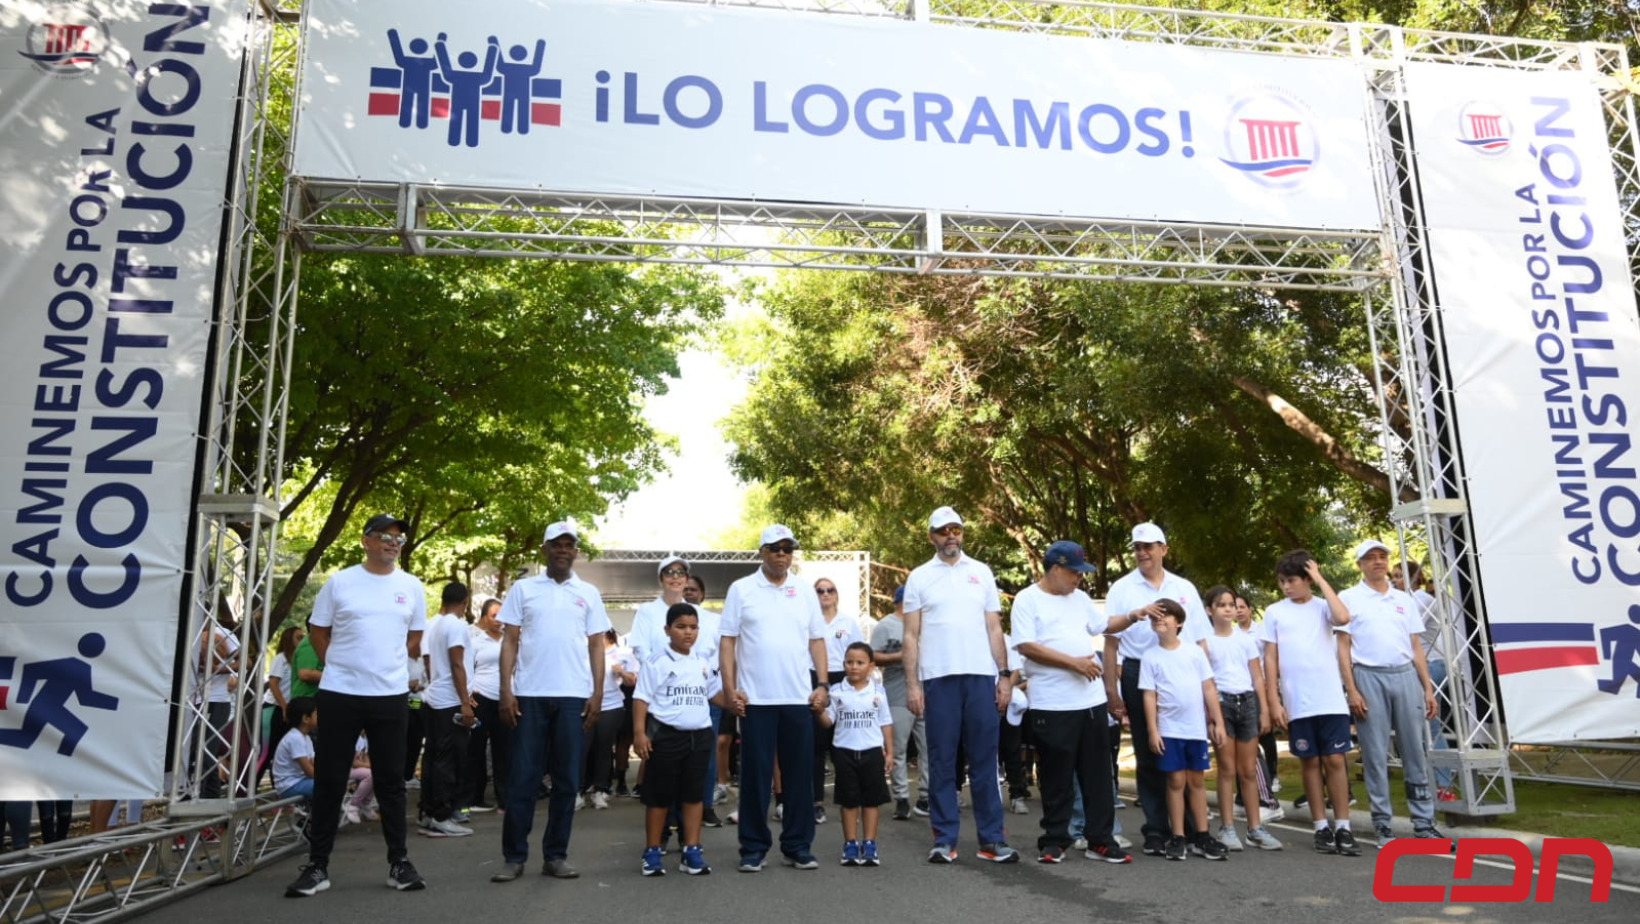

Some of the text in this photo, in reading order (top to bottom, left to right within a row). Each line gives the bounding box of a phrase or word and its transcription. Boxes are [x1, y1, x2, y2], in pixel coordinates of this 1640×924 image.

[5, 107, 121, 607] CAMINEMOS POR LA
[67, 3, 210, 609] CONSTITUCIÓN
[753, 80, 1196, 159] LOGRAMOS!
[1528, 96, 1640, 587] CONSTITUCIÓN
[1514, 183, 1601, 585] CAMINEMOS POR LA
